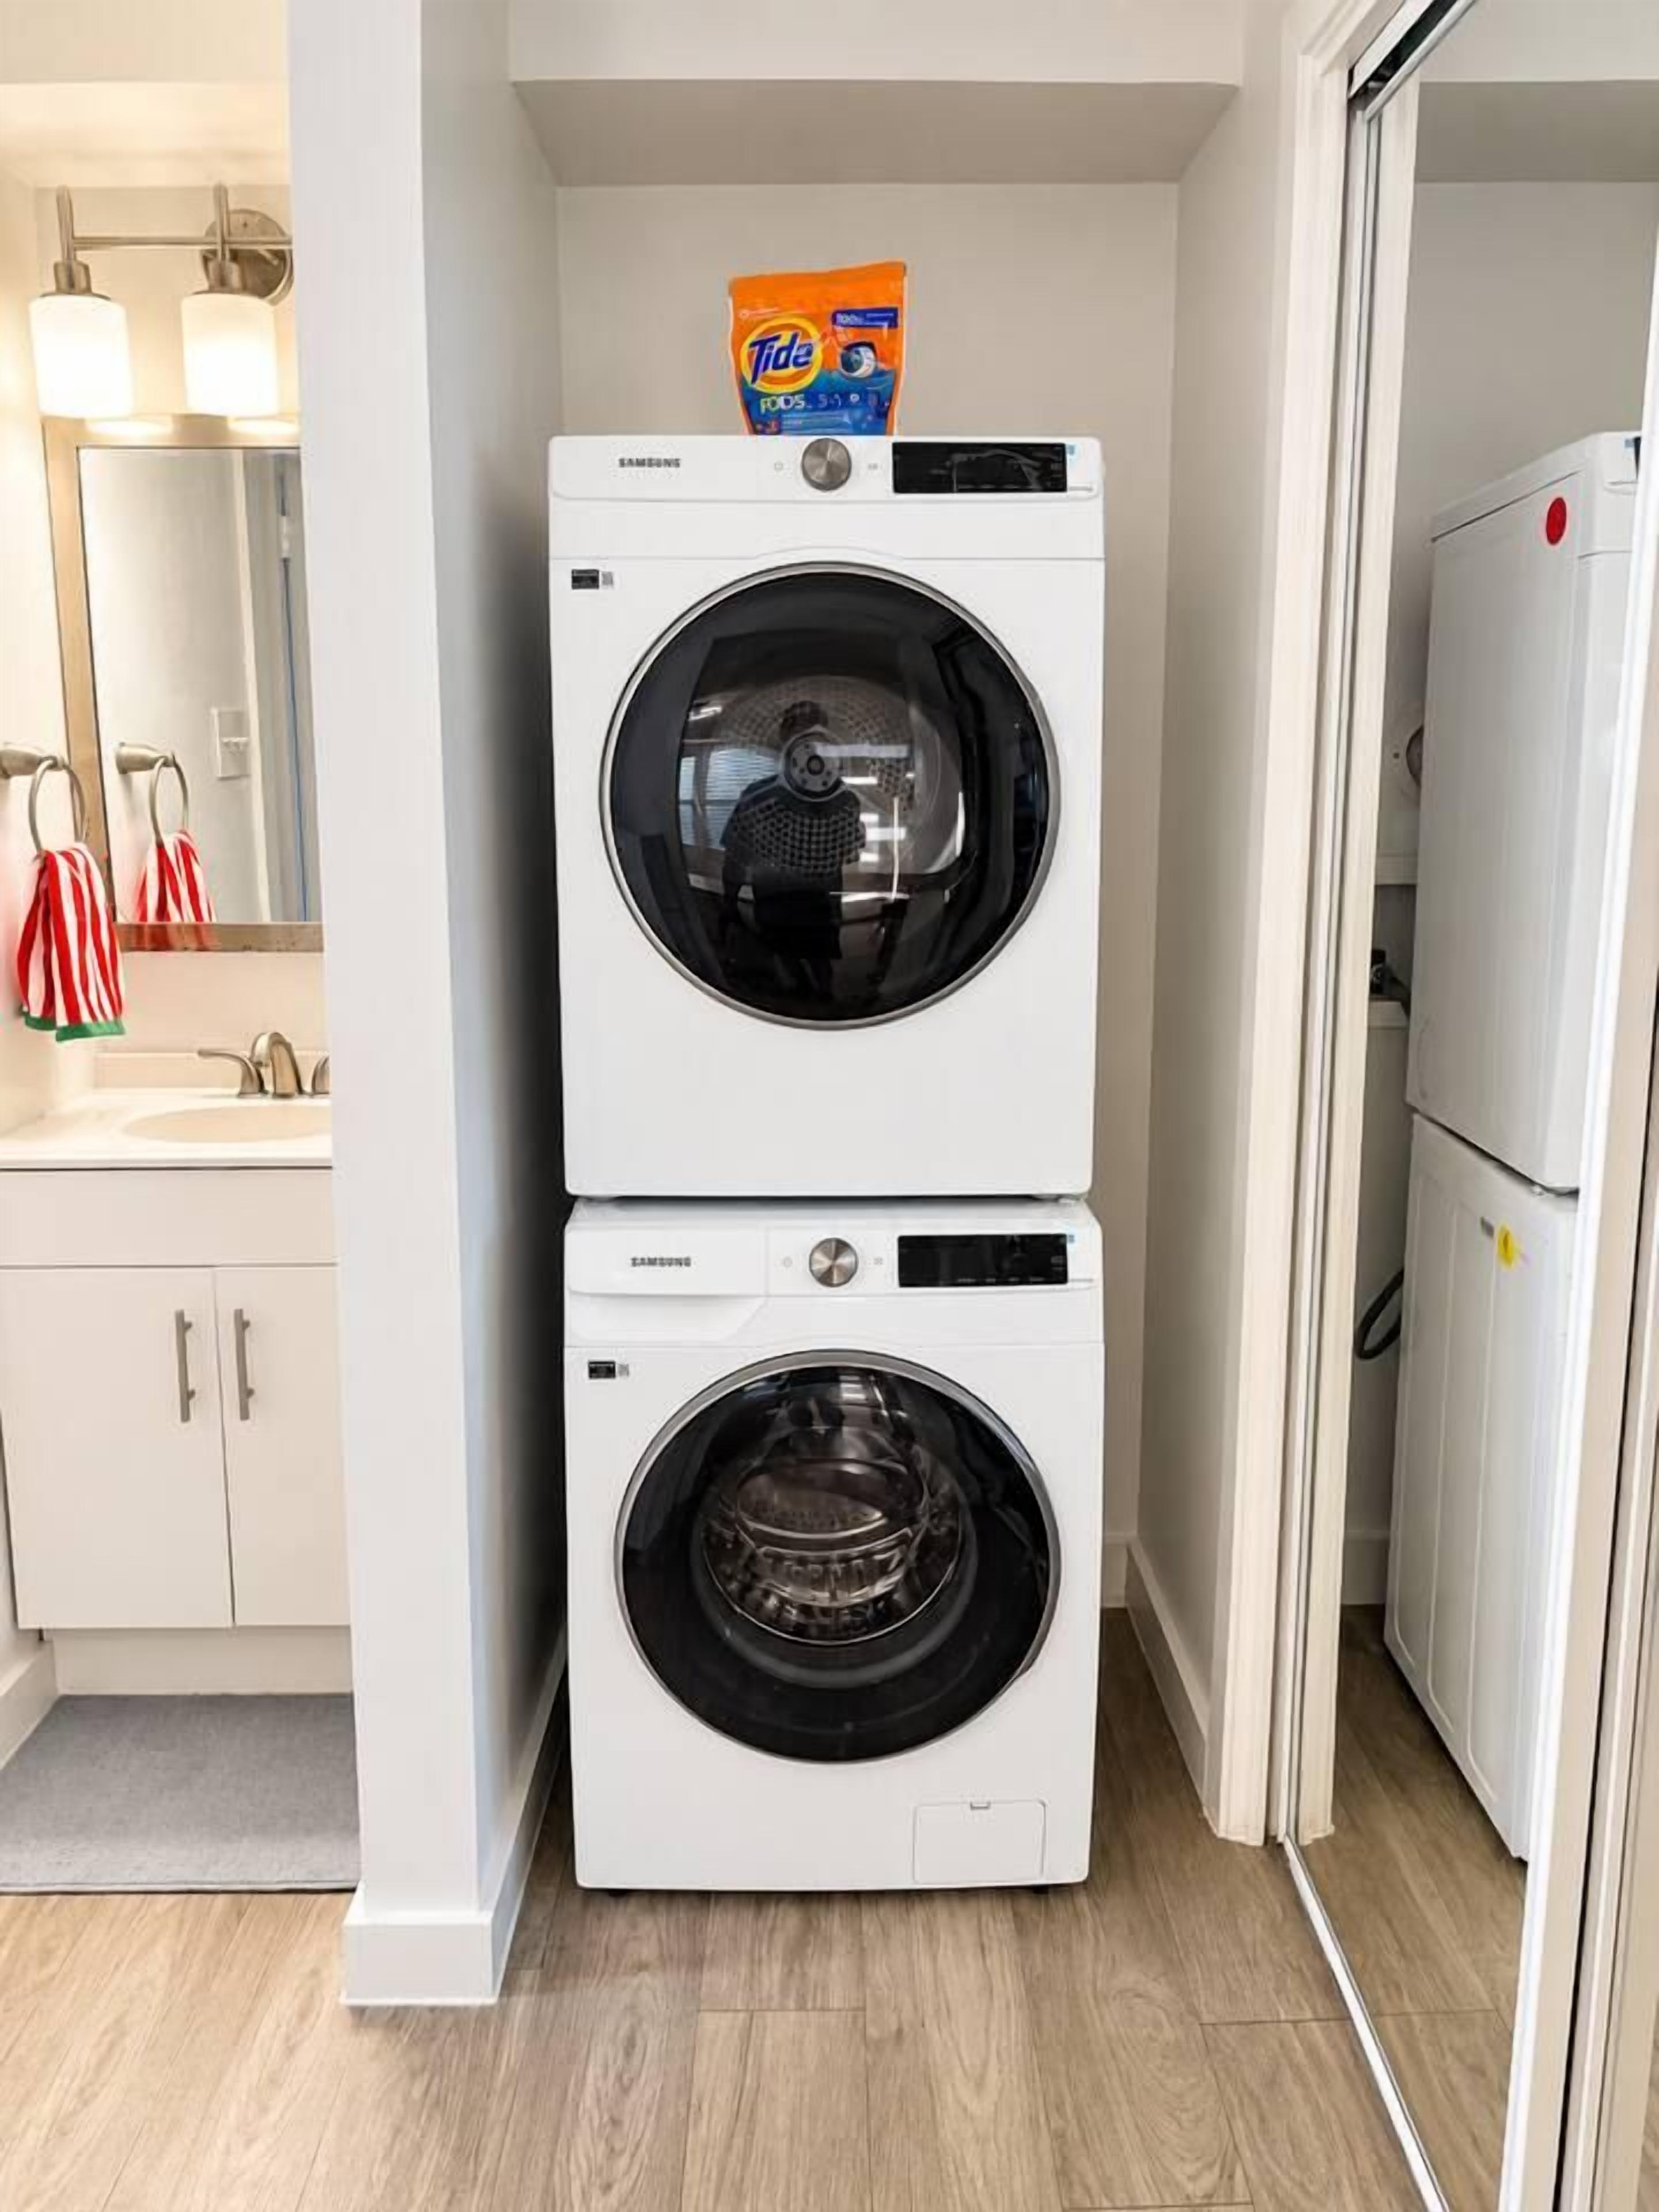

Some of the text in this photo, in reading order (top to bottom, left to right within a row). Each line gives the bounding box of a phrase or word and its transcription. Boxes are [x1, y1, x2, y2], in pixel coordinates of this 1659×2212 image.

[748, 330, 813, 384] Tide
[619, 458, 680, 467] SAMSUNG
[631, 1257, 691, 1267] SAMSUNG
